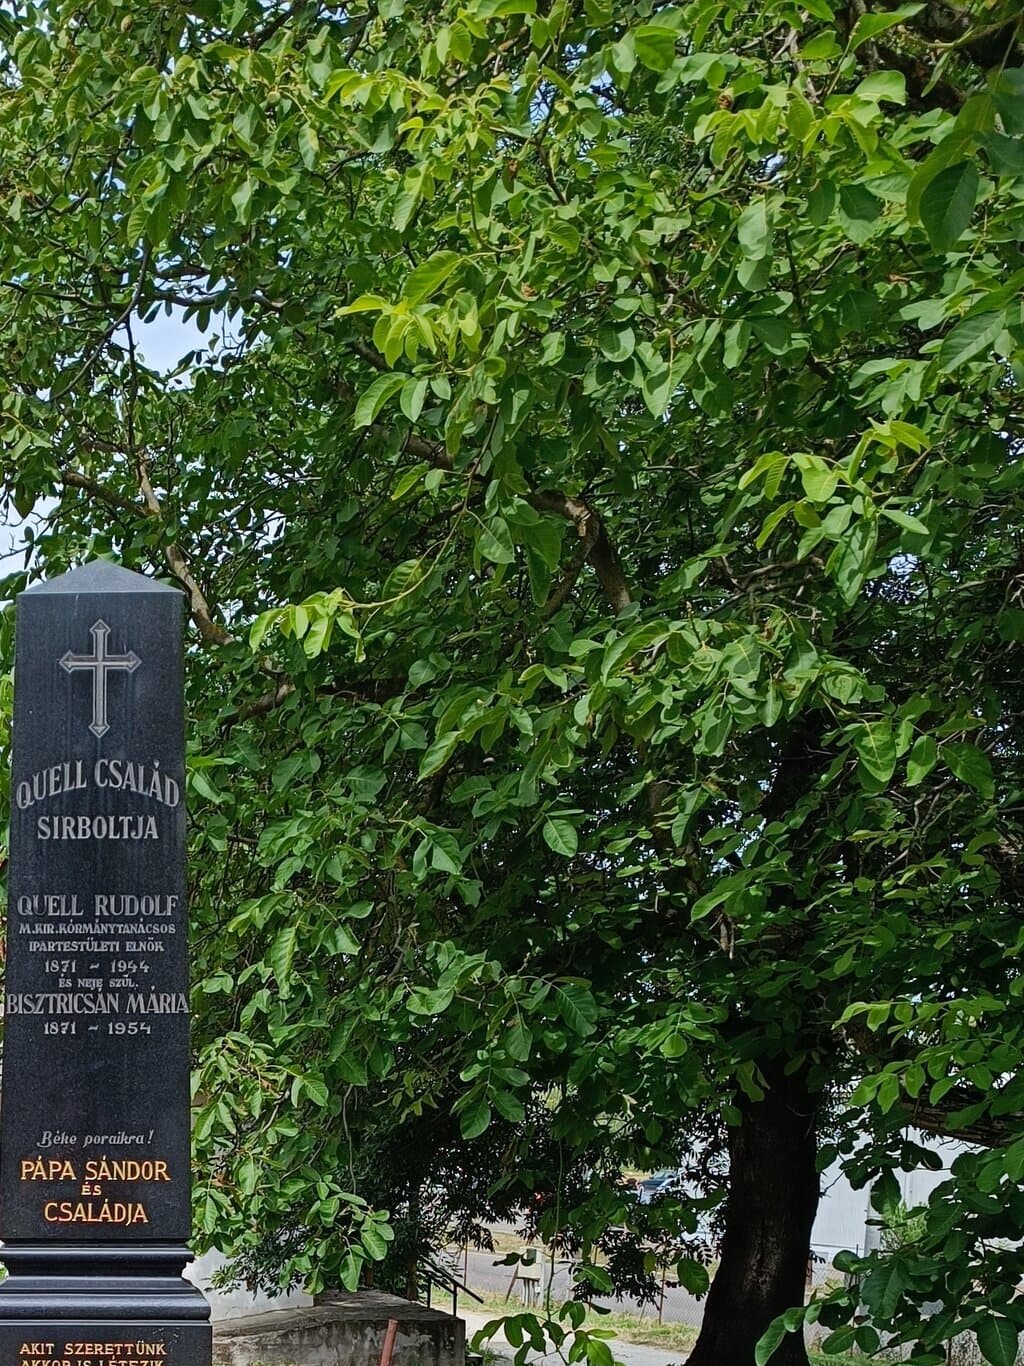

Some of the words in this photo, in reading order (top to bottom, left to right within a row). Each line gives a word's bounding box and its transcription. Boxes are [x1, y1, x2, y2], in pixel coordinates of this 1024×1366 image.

[16, 760, 87, 809] QUELL
[94, 759, 180, 808] CSALÁD
[37, 816, 158, 840] SIRBOLTJA
[17, 895, 84, 916] QUELL
[95, 894, 178, 916] RUDOLF
[29, 938, 120, 952] IPARTESTÜLETI
[126, 938, 164, 952] ELNÖK
[45, 959, 76, 972] 1871
[111, 959, 150, 973] 1944
[58, 974, 72, 988] ÉS
[78, 978, 103, 989] NEJE
[6, 988, 119, 1014] BISZTRICSÁN
[126, 986, 189, 1014] MÁRIA
[44, 1021, 76, 1034] 1871
[108, 1022, 151, 1034] 1954
[37, 1131, 77, 1148] Béke
[20, 1155, 76, 1181] PÁPA
[86, 1155, 171, 1181] SÁNDOR
[81, 1182, 102, 1195] ÉS
[44, 1199, 149, 1226] CSALÁDJA
[20, 1343, 54, 1355] AKIT
[64, 1340, 166, 1355] SZERETTÜNK
